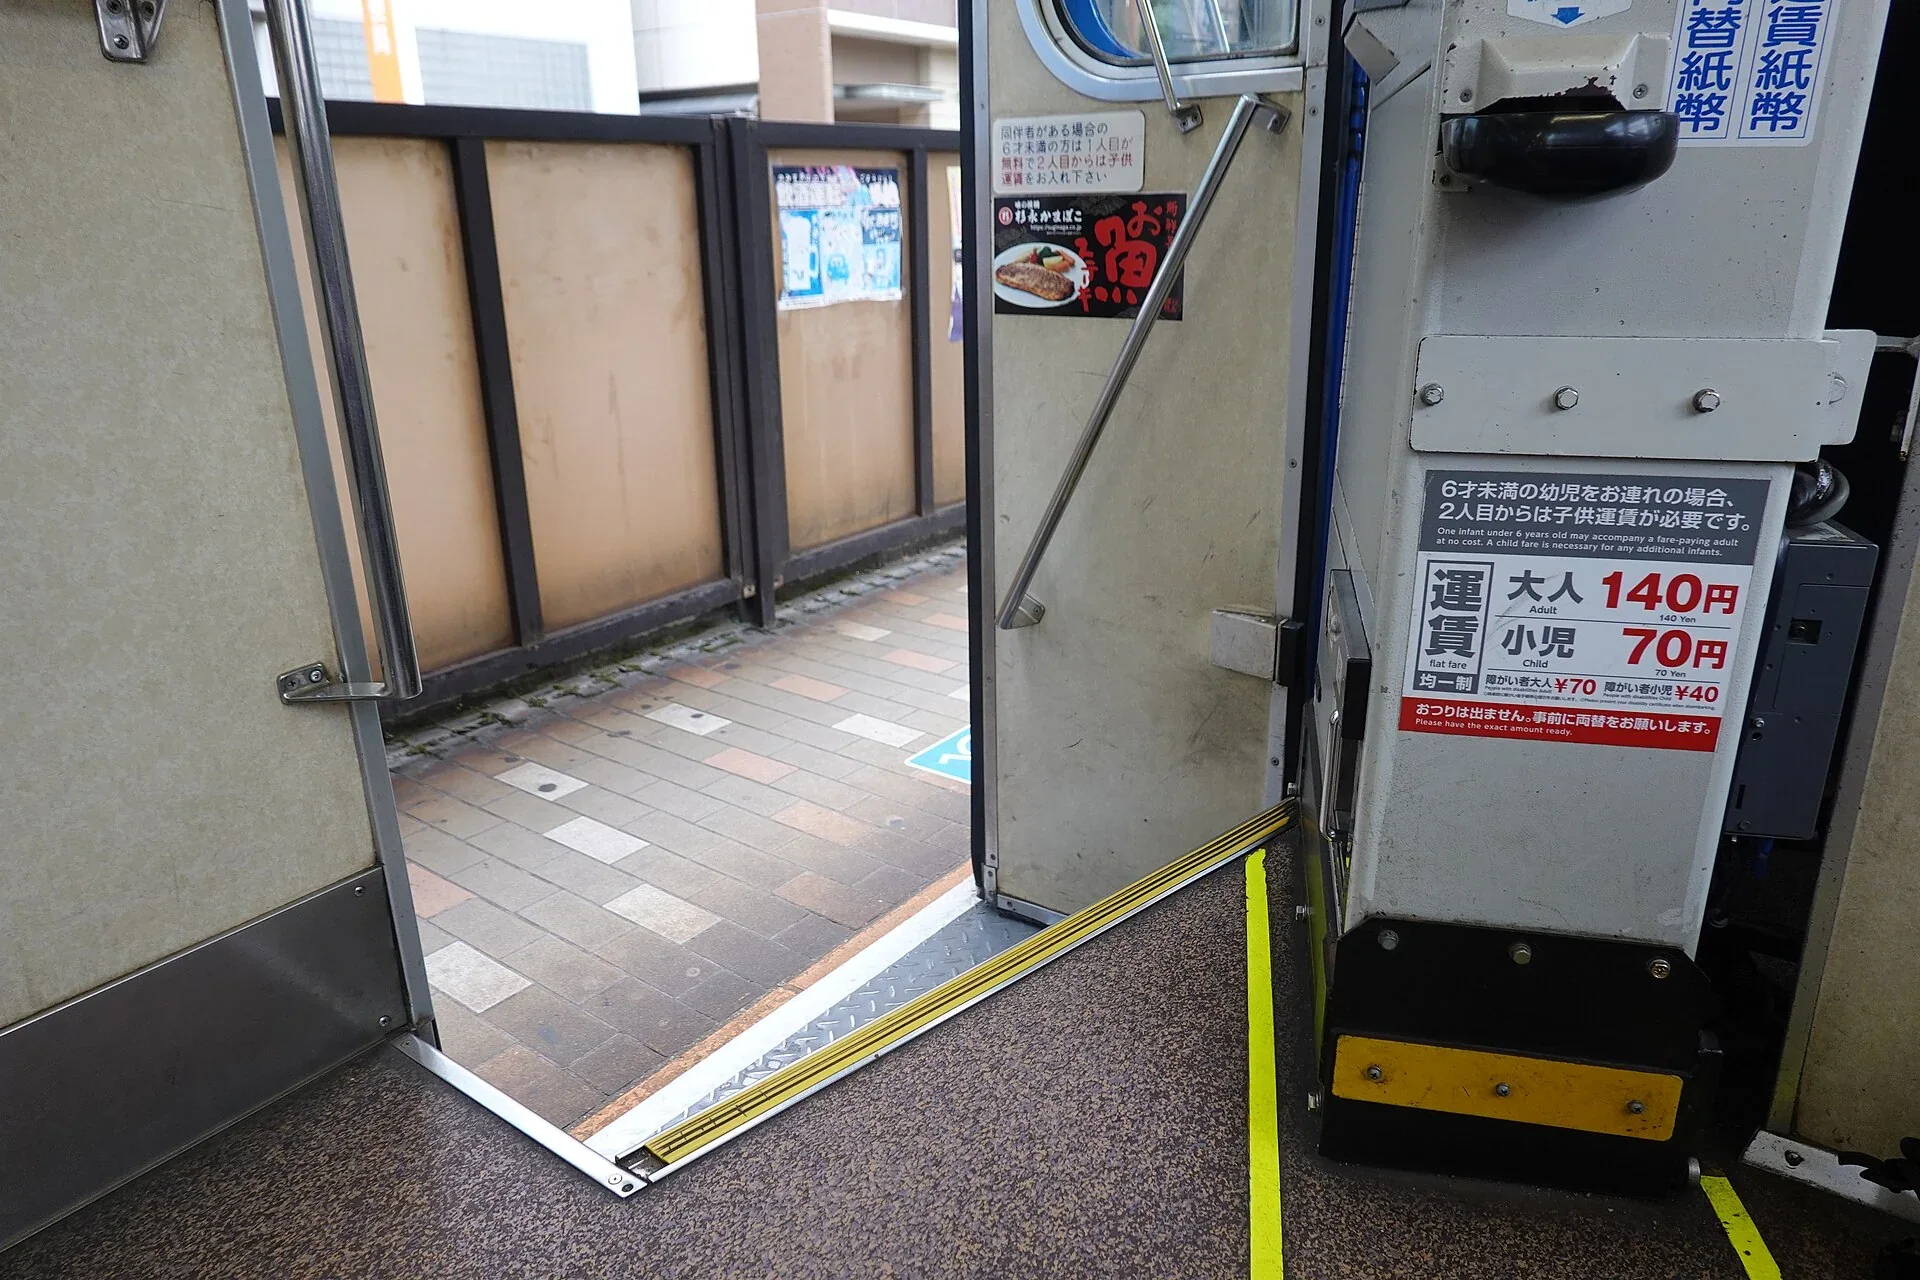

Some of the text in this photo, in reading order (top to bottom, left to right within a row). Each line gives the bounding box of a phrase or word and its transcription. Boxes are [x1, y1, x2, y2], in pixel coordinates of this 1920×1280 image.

[1674, 0, 1743, 133] 替紙幣
[1749, 0, 1824, 132] 賃紙幣
[1001, 121, 1108, 140] 同伴者がある場合の
[1002, 152, 1133, 171] 無料で2人目からは子供
[1002, 170, 1108, 187] 運賃をお入れ下さい
[1441, 480, 1735, 507] 6才未満の幼児をお連れの場合、
[1438, 502, 1750, 532] 2人目からは子供運賃が必要です。
[1437, 527, 1456, 535] One
[1458, 527, 1484, 536] infant
[1487, 529, 1513, 537] under
[1525, 531, 1549, 539] years
[1552, 531, 1567, 539] old
[1570, 533, 1590, 541] may
[1592, 534, 1645, 543] accompany
[1657, 535, 1711, 547] fare-paying
[1713, 538, 1739, 547] adult
[1462, 538, 1483, 546] cost.
[1496, 539, 1519, 547] child
[1521, 540, 1539, 548] fare
[1552, 542, 1598, 551] necessary
[1601, 543, 1615, 551] for
[1617, 545, 1633, 553] any
[1637, 545, 1685, 554] additional
[1687, 546, 1723, 557] infants.
[1507, 569, 1583, 604] 大人
[1601, 571, 1739, 615] 140円
[1425, 568, 1485, 659] 運賃
[1529, 605, 1557, 615] Adult
[1659, 614, 1696, 623] 140 Yen
[1501, 624, 1576, 658] 小児
[1622, 627, 1728, 670] 70円
[1429, 659, 1467, 670] flat fare
[1522, 659, 1548, 668] Child
[1419, 673, 1473, 691] 均一制
[1670, 670, 1686, 678] Yen
[1485, 674, 1597, 695] 障がい者大人 ¥70
[1604, 681, 1719, 703] 障がい者小児 ¥40
[1415, 703, 1711, 735] おつりは出ません。事前に両替をお願いします。
[1415, 718, 1573, 737] Please have the exact amount ready.
